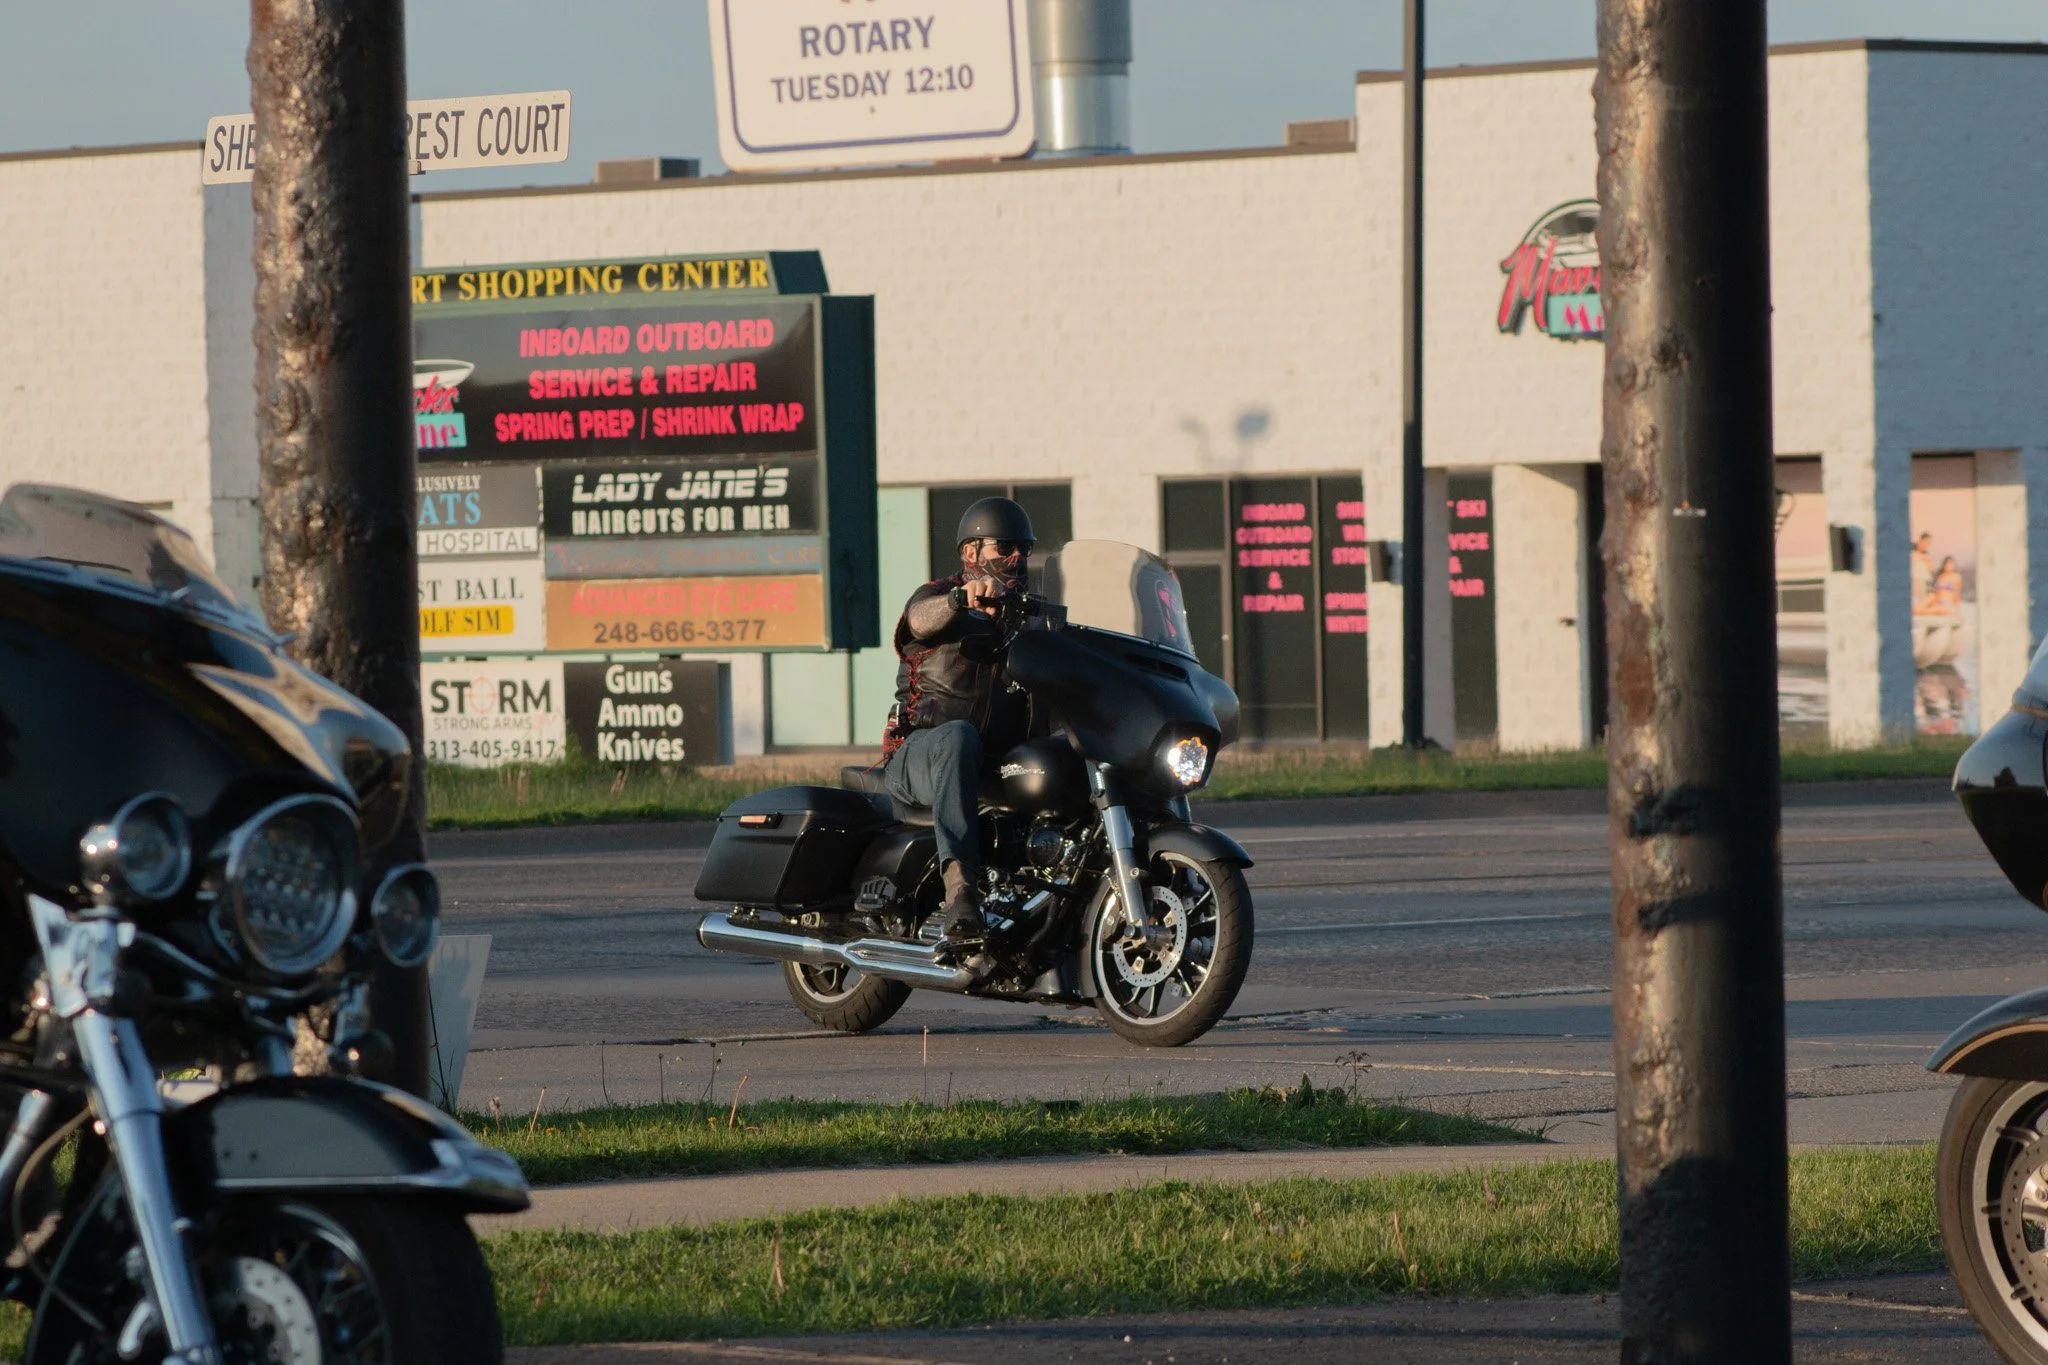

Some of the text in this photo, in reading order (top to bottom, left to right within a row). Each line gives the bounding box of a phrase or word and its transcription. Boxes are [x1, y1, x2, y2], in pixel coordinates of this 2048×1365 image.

[800, 16, 934, 58] ROTARY
[771, 64, 973, 103] TUESDAY 12:10
[477, 103, 565, 157] COURT
[458, 264, 623, 301] SHOPPING
[637, 258, 768, 293] CENTER
[520, 319, 774, 358] INBOARD OUTBOARD
[528, 362, 757, 400] SERVICE & REPAIR
[494, 411, 575, 443] SPRING
[579, 408, 635, 440] PREP
[652, 404, 736, 438] SHRINK
[740, 402, 804, 434] WRAP
[572, 466, 789, 503] LADY JANE'S
[418, 491, 481, 526] ATS
[572, 503, 790, 536] HAIRCUTS FOR MEN
[426, 531, 532, 553] HOSPITAL
[456, 577, 524, 600] BALL
[571, 583, 797, 617] ADVANCED EYE CARE
[463, 607, 502, 632] SIM
[593, 620, 766, 644] 248-666-3377
[605, 664, 673, 694] Guns
[433, 716, 532, 730] STRONG ARMS
[598, 697, 684, 727] Ammo
[429, 740, 556, 759] 313-405-9417
[598, 731, 685, 762] Knives
